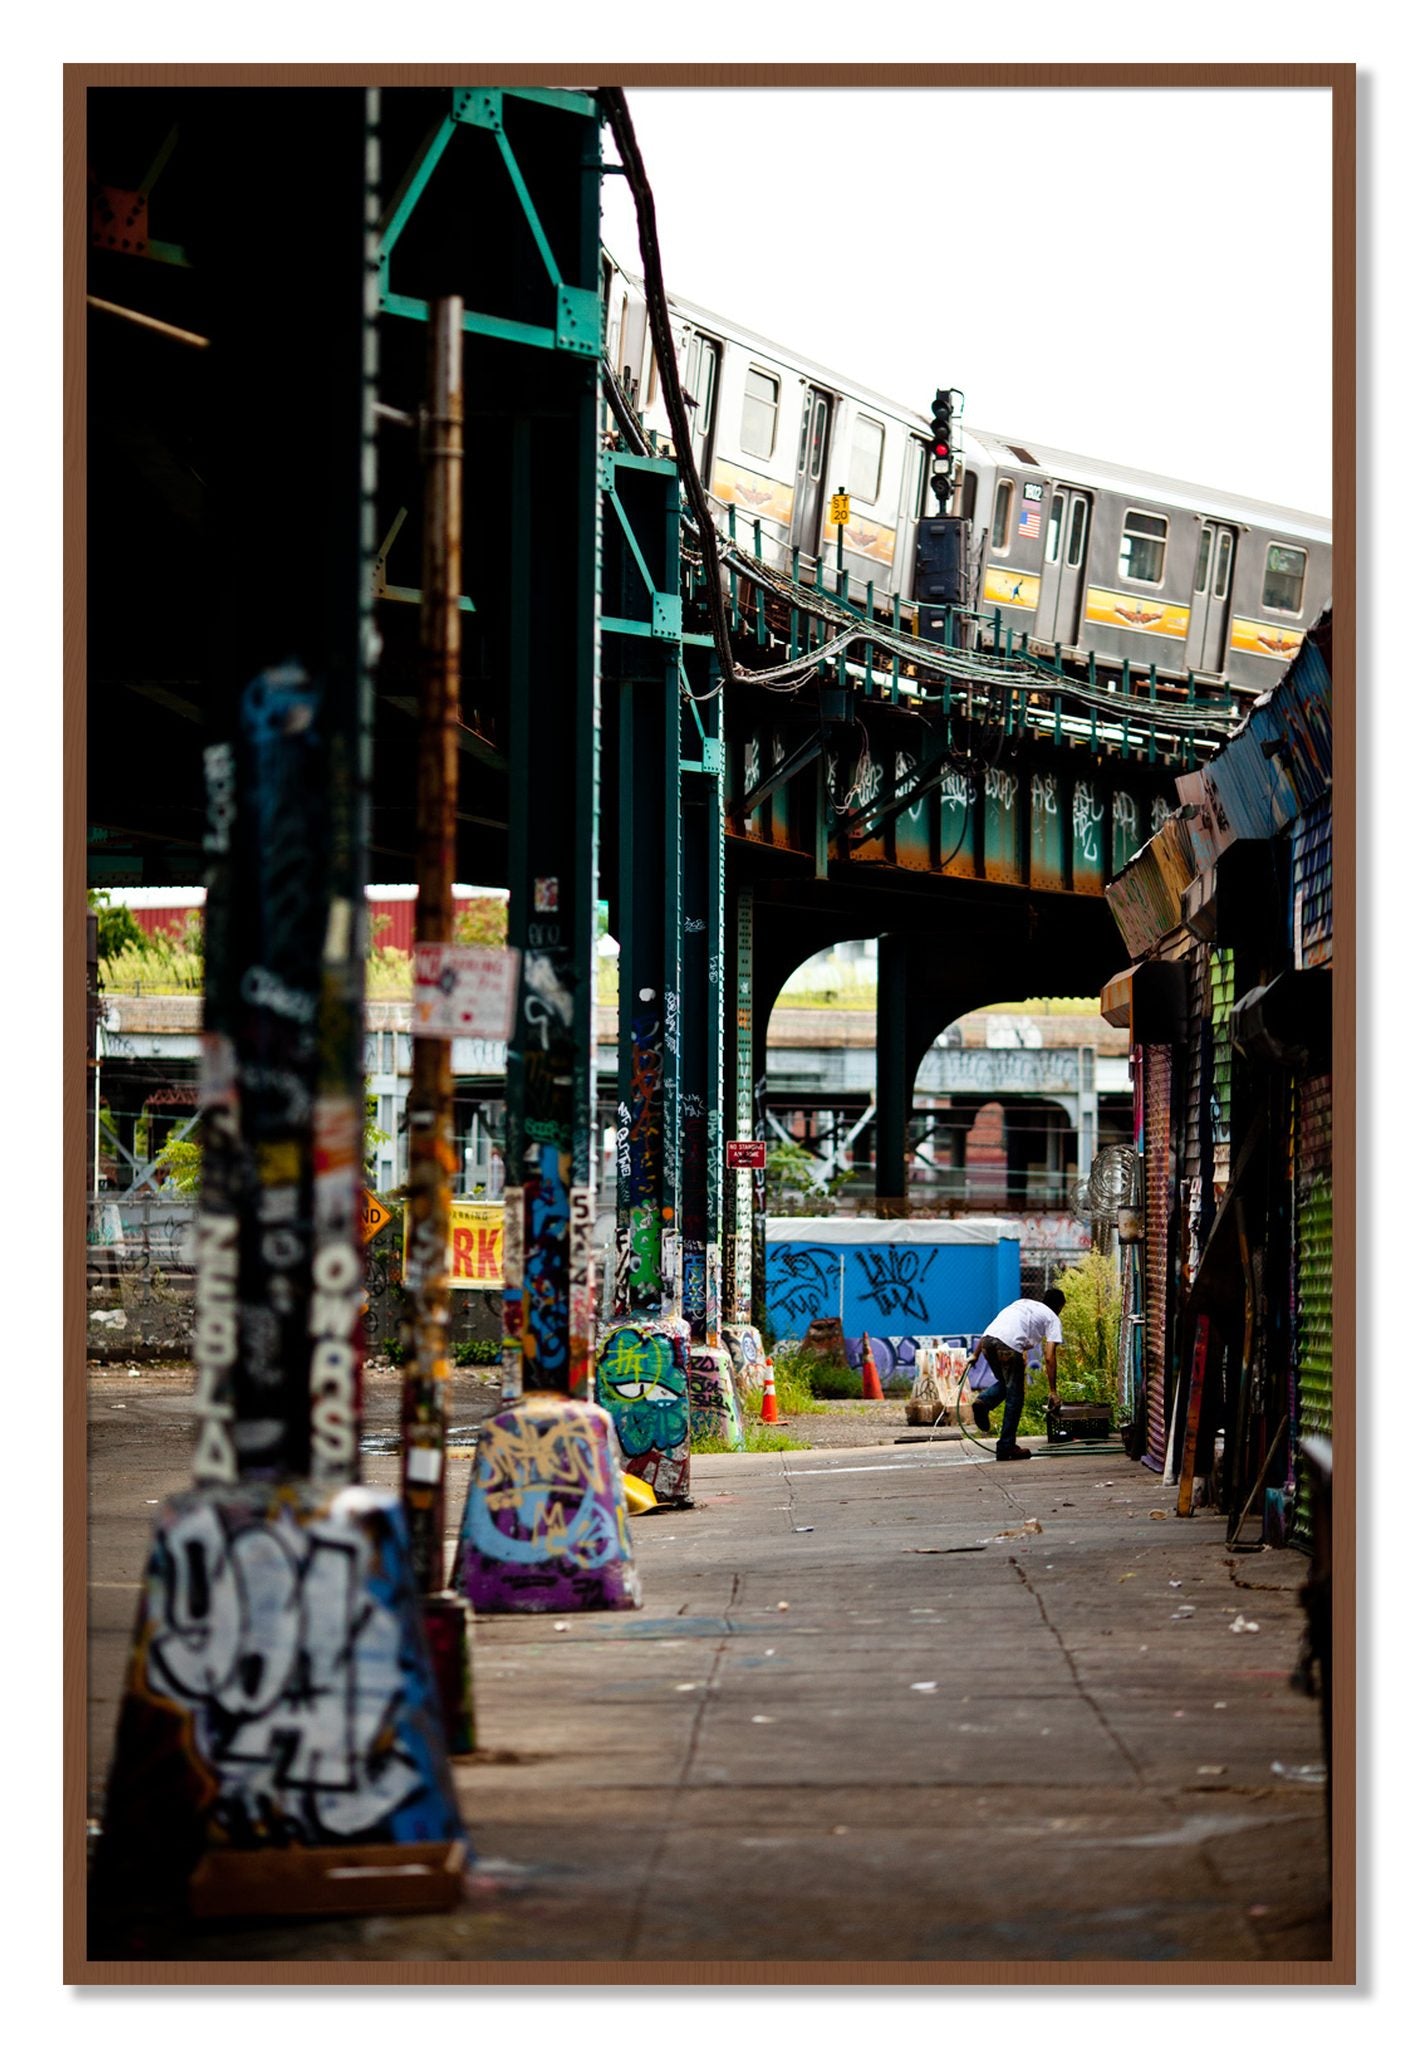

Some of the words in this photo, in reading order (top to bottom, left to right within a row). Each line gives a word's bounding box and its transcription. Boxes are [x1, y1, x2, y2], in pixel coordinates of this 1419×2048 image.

[834, 510, 848, 520] 20
[362, 1209, 381, 1224] ND
[450, 1211, 489, 1221] ARKING
[453, 1227, 499, 1278] RK
